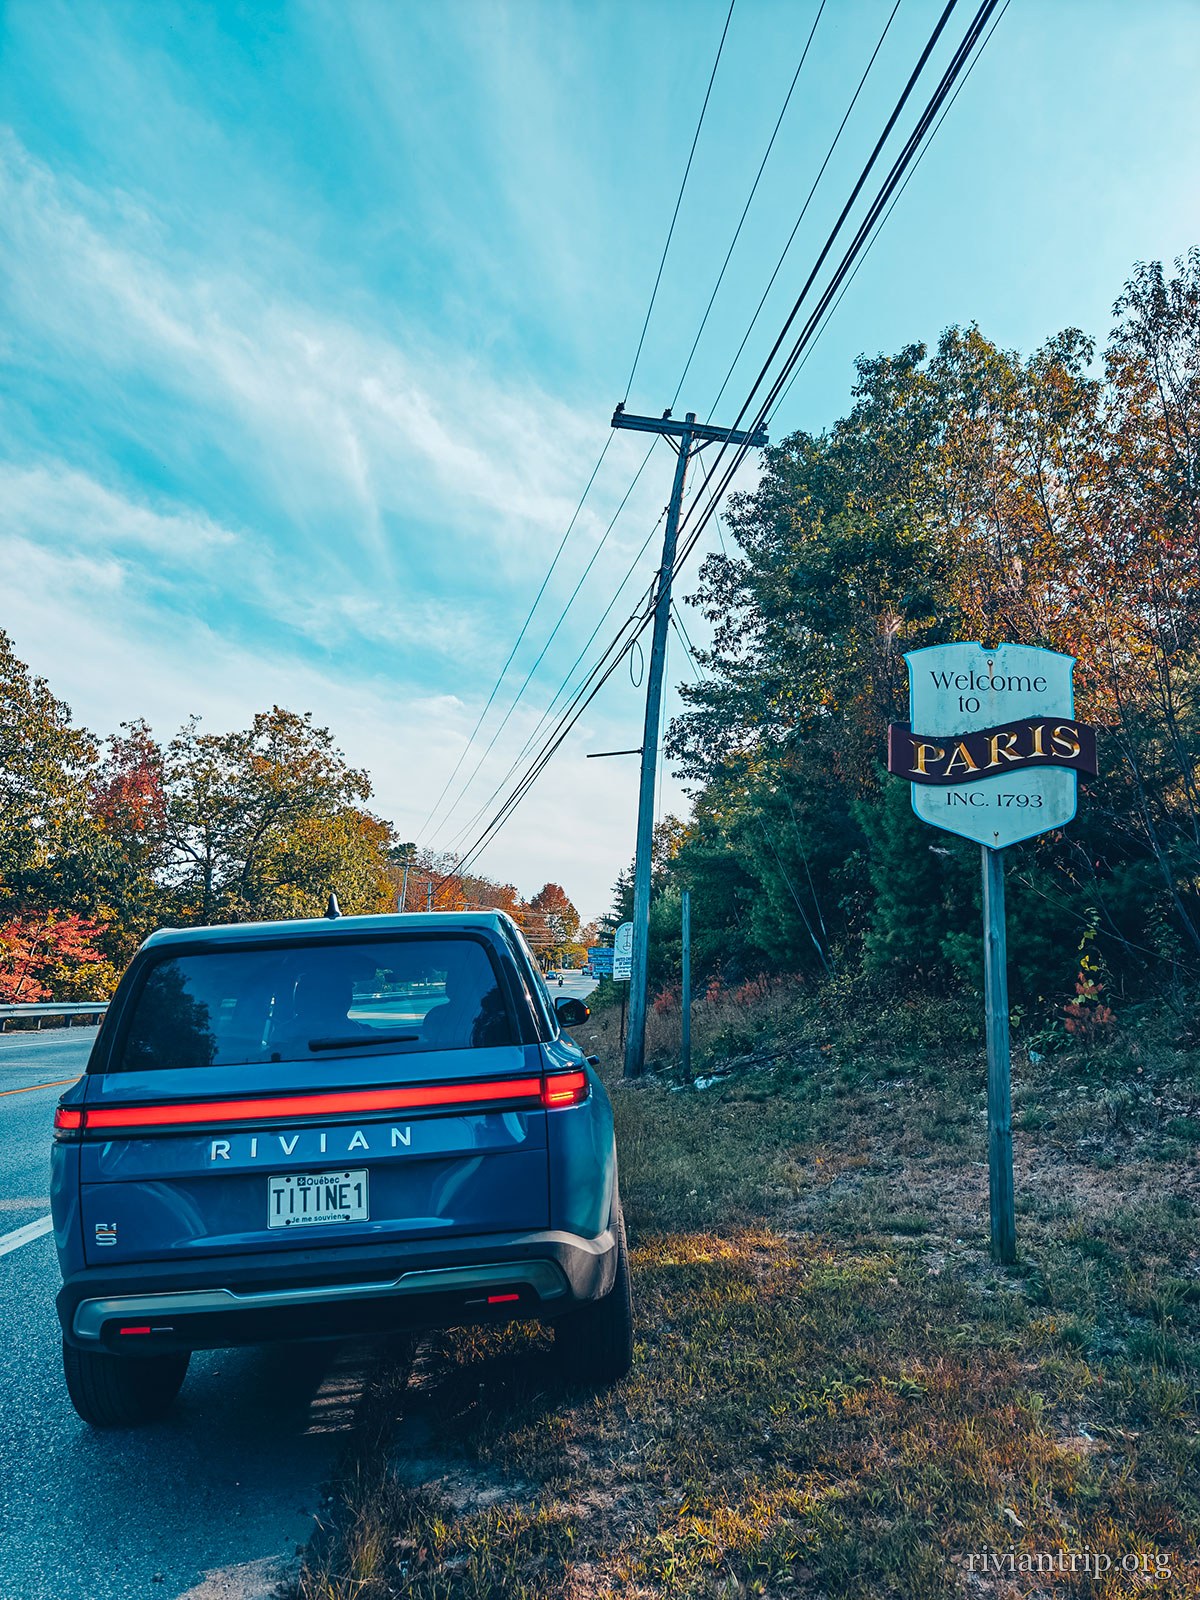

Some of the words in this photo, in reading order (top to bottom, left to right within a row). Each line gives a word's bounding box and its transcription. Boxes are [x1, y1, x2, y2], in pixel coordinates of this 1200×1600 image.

[930, 671, 1047, 693] Welcome
[959, 695, 980, 713] to
[908, 724, 1081, 777] PARIS
[947, 792, 989, 807] INC.
[997, 794, 1043, 808] 1793
[210, 1126, 412, 1161] RIVIAN
[306, 1176, 340, 1186] Québec
[273, 1182, 362, 1214] TITINE1
[314, 1213, 346, 1222] souviens
